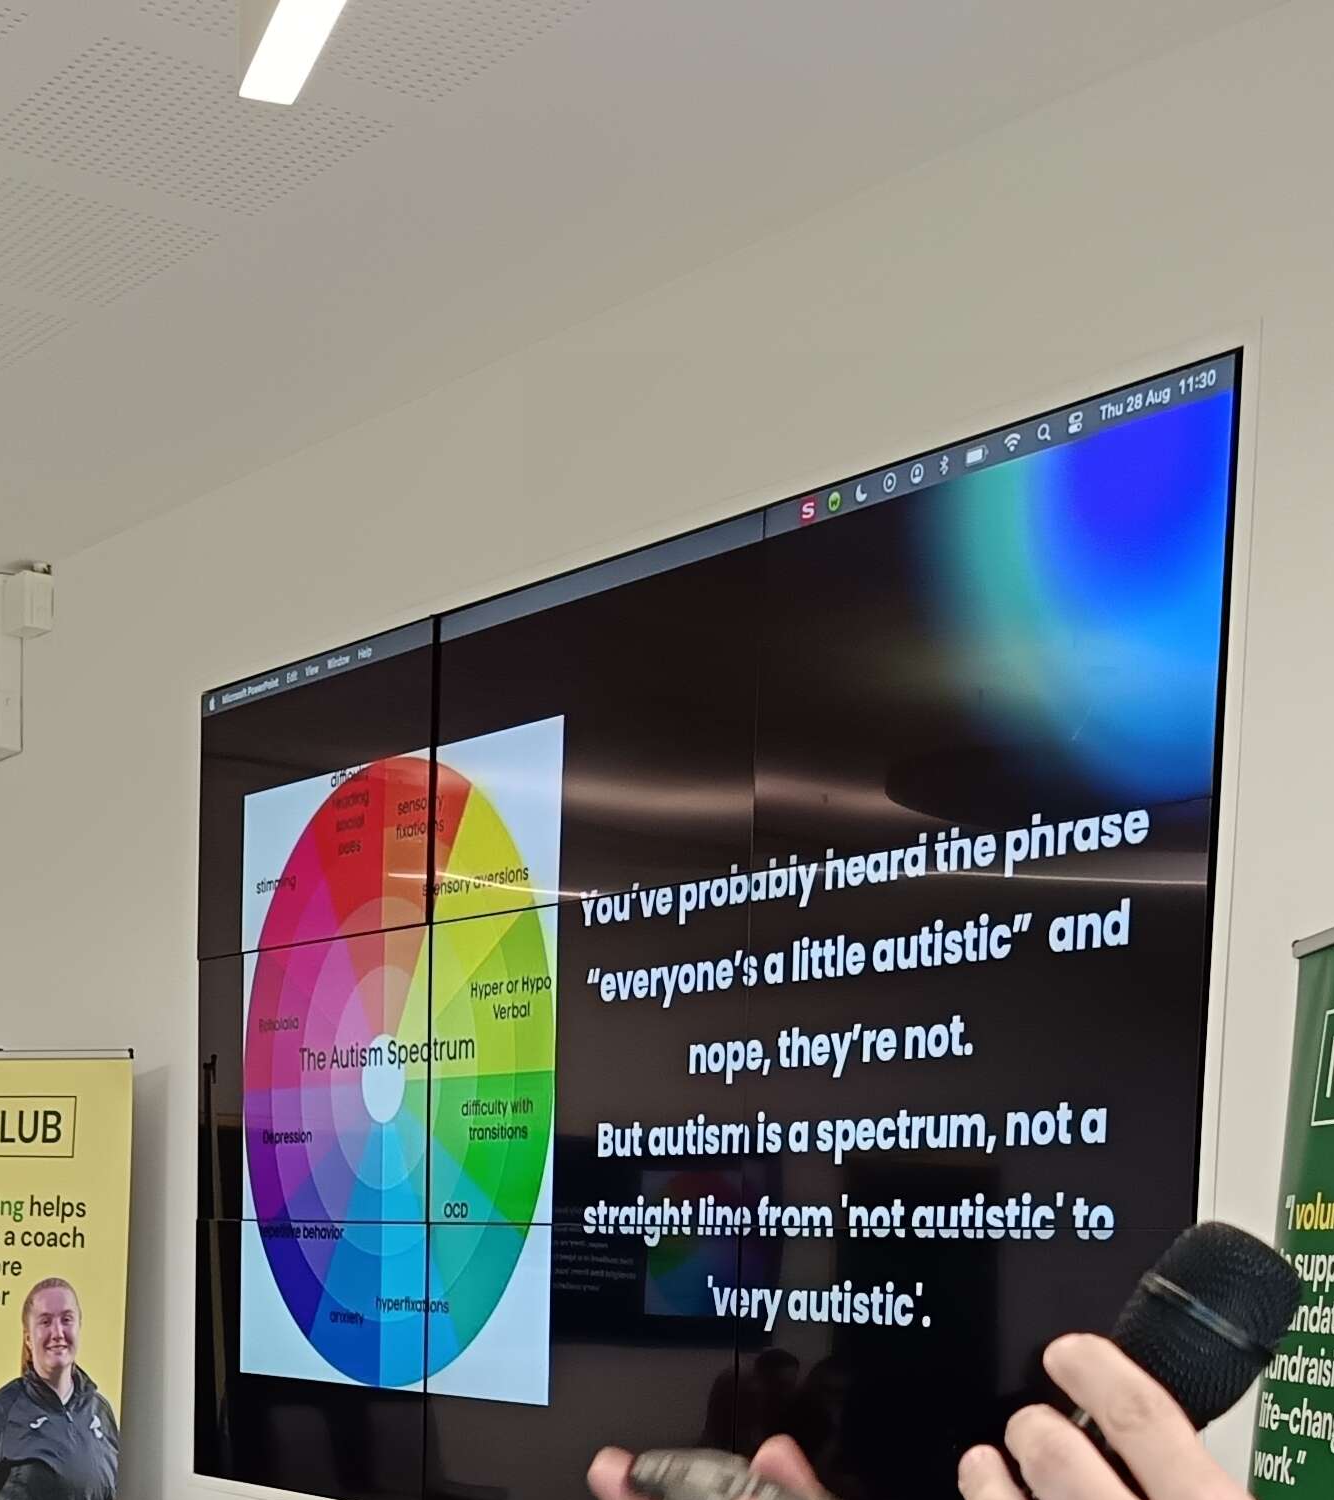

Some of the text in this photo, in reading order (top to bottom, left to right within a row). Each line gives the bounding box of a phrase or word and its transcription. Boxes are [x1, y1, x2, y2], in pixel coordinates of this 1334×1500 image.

[1100, 369, 1217, 421] Thu 28 Aug 11:30
[286, 670, 298, 684] Edit
[305, 664, 319, 677] View
[327, 655, 350, 670] Window
[473, 865, 529, 891] aversions
[581, 808, 1150, 927] You've probably heard the phrase
[256, 873, 296, 895] stimming
[587, 899, 1130, 1008] "everyone's a little autistic" and
[471, 975, 552, 1000] Hyper or Hypo
[493, 1002, 530, 1021] Verbal
[299, 1037, 476, 1072] The Autism Spectrum
[688, 1015, 973, 1084] nope, they're not.
[461, 1098, 534, 1118] difficulty with
[262, 1129, 313, 1145] Depression
[468, 1123, 528, 1141] transitions
[597, 1102, 1108, 1165] But autism is a spectrum, not a
[28, 1195, 87, 1223] helps
[443, 1202, 469, 1219] OCD
[583, 1192, 1115, 1247] straight line from 'not autistic' to
[4, 1230, 16, 1247] a
[21, 1226, 86, 1249] coach
[303, 1224, 345, 1241] behavior
[375, 1296, 449, 1314] hyperfixations
[707, 1276, 931, 1332] 'very autistic'.
[329, 1309, 364, 1326] anxiety
[1253, 1446, 1307, 1486] work."
